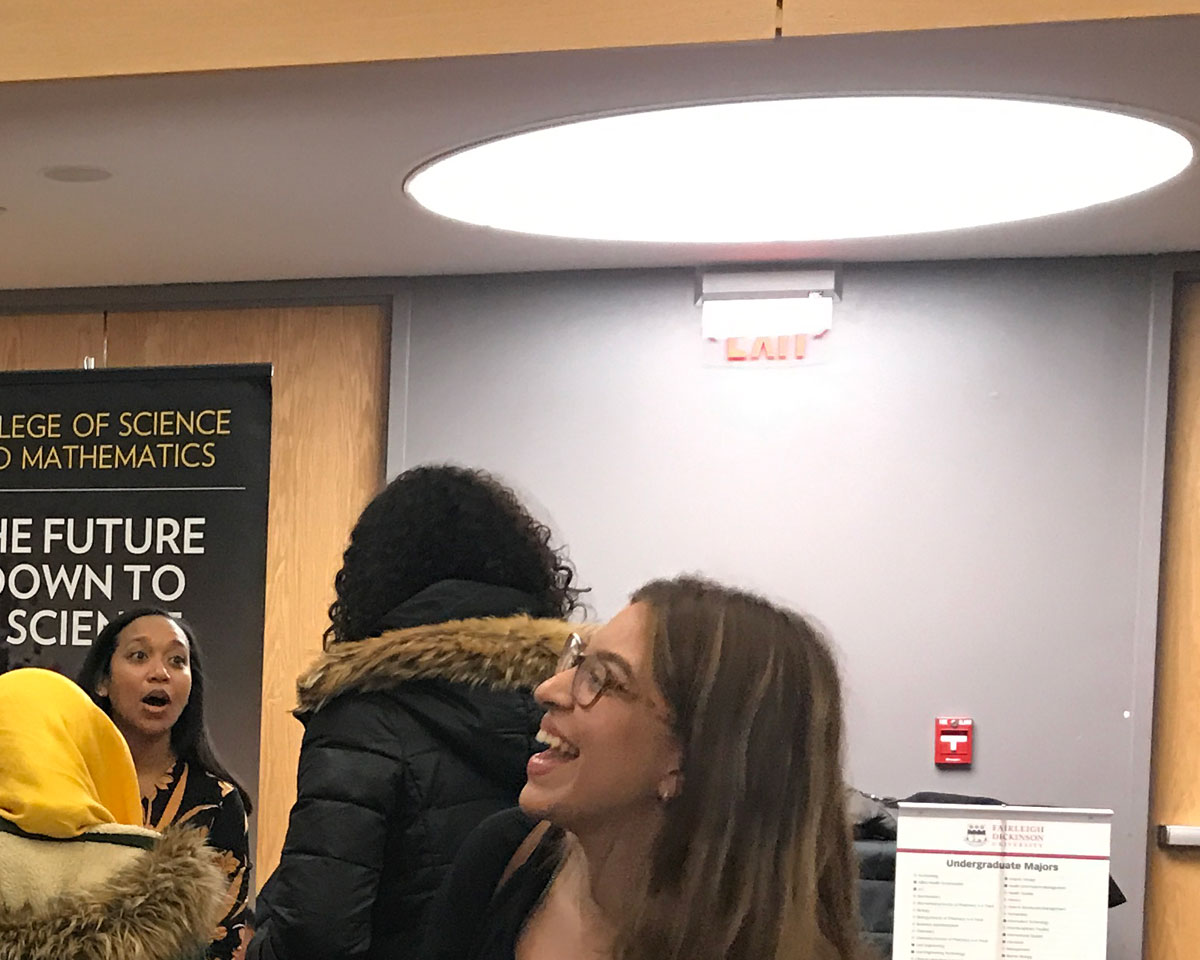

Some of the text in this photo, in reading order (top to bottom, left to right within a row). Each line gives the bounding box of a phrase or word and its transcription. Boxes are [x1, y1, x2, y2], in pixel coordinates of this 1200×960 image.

[72, 412, 110, 438] OF
[118, 409, 232, 437] SCIENCE
[21, 442, 216, 470] MATHEMATICS
[43, 517, 206, 555] FUTURE
[123, 564, 186, 602] TO
[6, 608, 182, 646] SCIE
[992, 824, 1045, 833] FAIRLEIGH
[992, 833, 1044, 841] DICKINSON
[946, 859, 1059, 872] Undergraduate Majors
